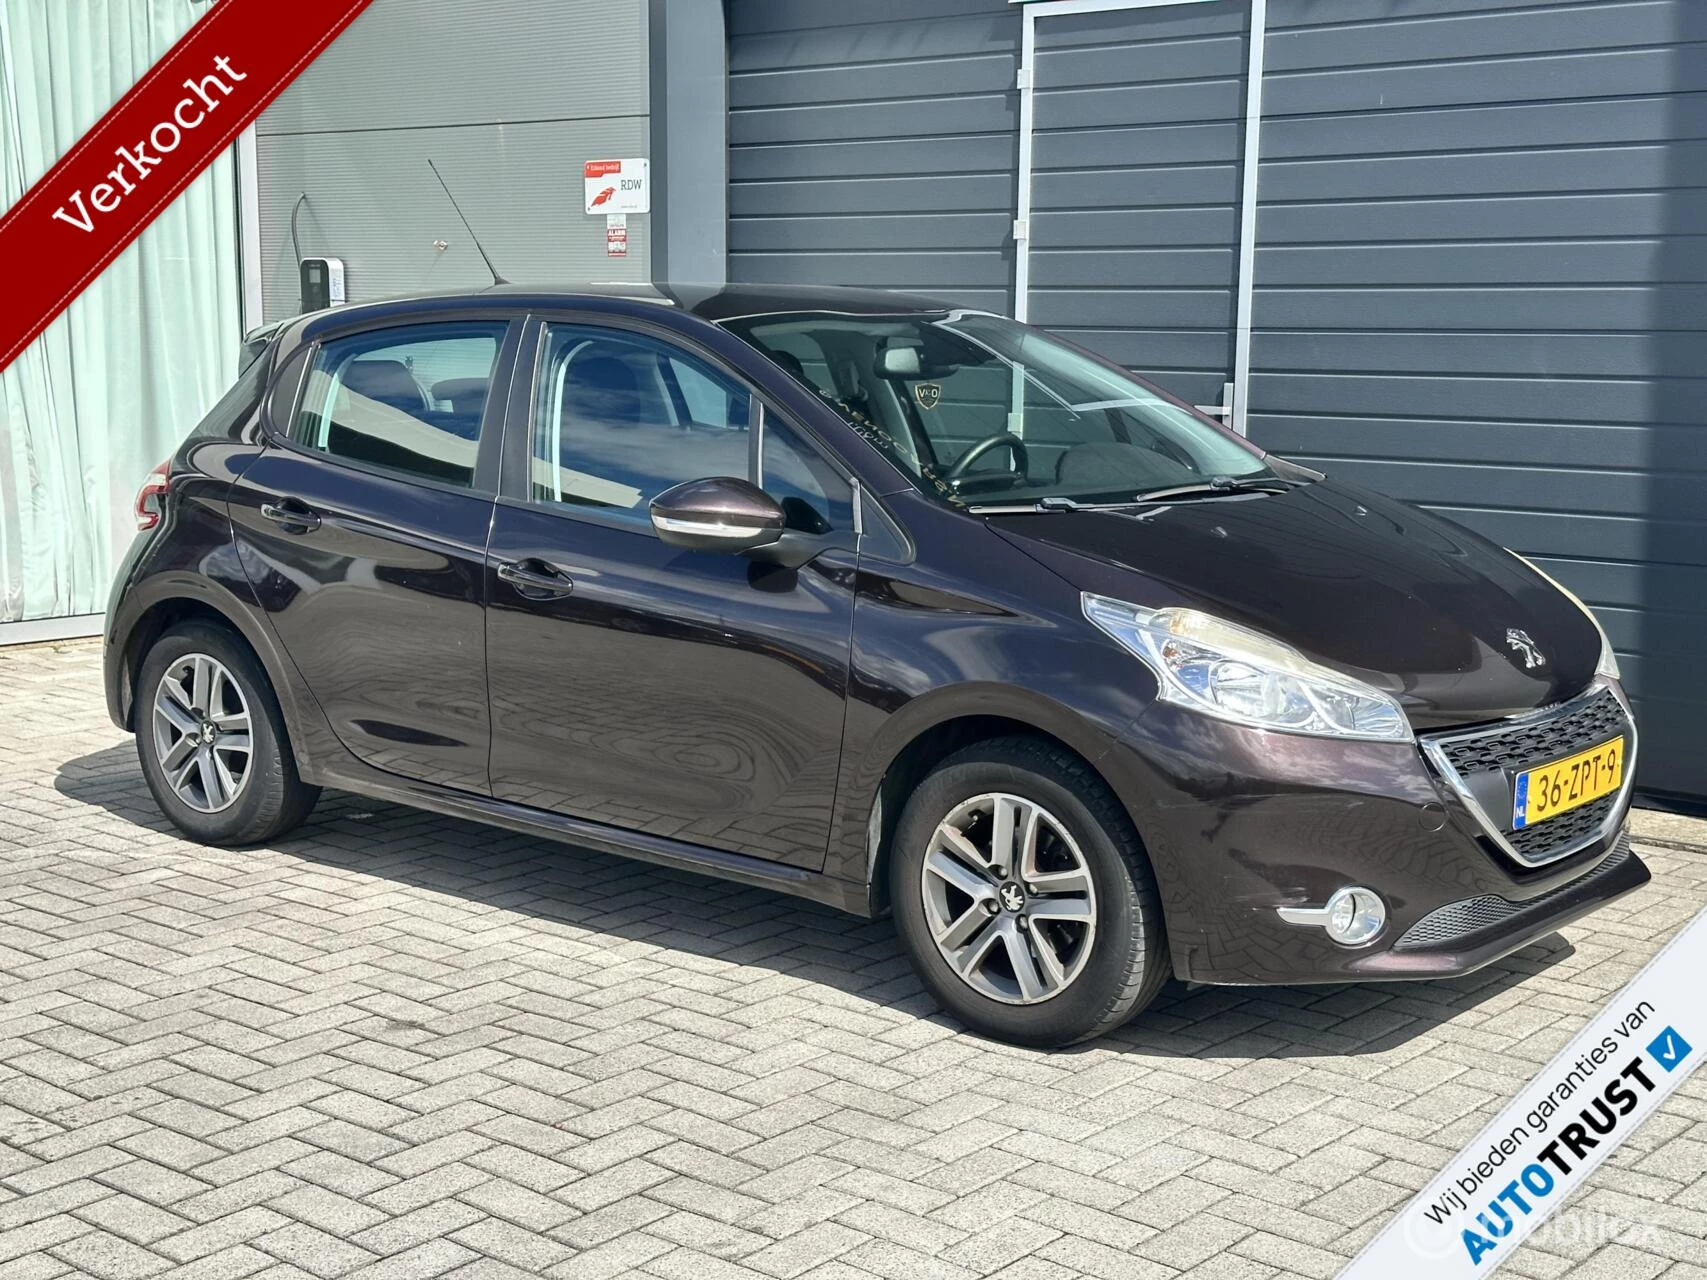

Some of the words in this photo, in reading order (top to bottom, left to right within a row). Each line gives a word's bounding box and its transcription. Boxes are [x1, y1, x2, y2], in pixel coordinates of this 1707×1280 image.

[620, 179, 642, 191] RDW
[1537, 748, 1616, 812] 36-ZPT-9
[1516, 806, 1525, 818] NL
